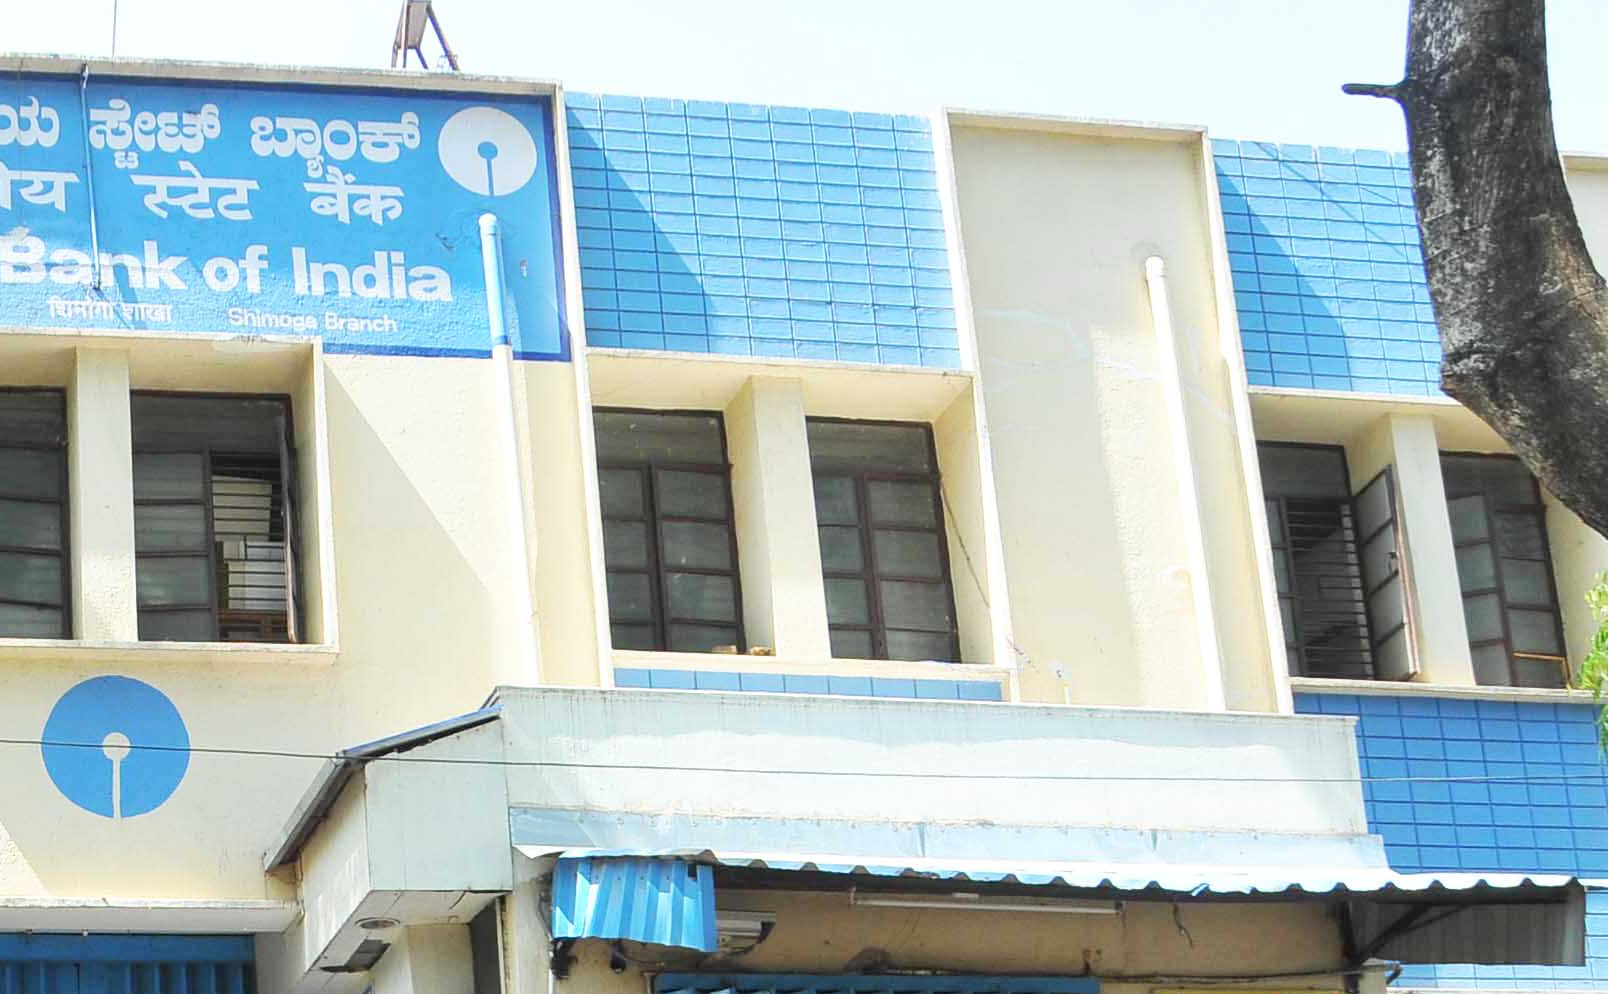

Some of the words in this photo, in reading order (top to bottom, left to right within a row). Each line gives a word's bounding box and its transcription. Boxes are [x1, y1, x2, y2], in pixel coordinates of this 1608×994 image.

[88, 98, 221, 169] ಸ್ಟೇಟ್
[250, 111, 421, 178] ಬ್ಯಾಂಕ್
[130, 160, 260, 220] स्टेट
[303, 165, 405, 225] बैंक
[202, 244, 269, 294] of
[292, 246, 453, 302] India
[228, 306, 317, 331] Shimoga
[325, 312, 397, 334] Branch
